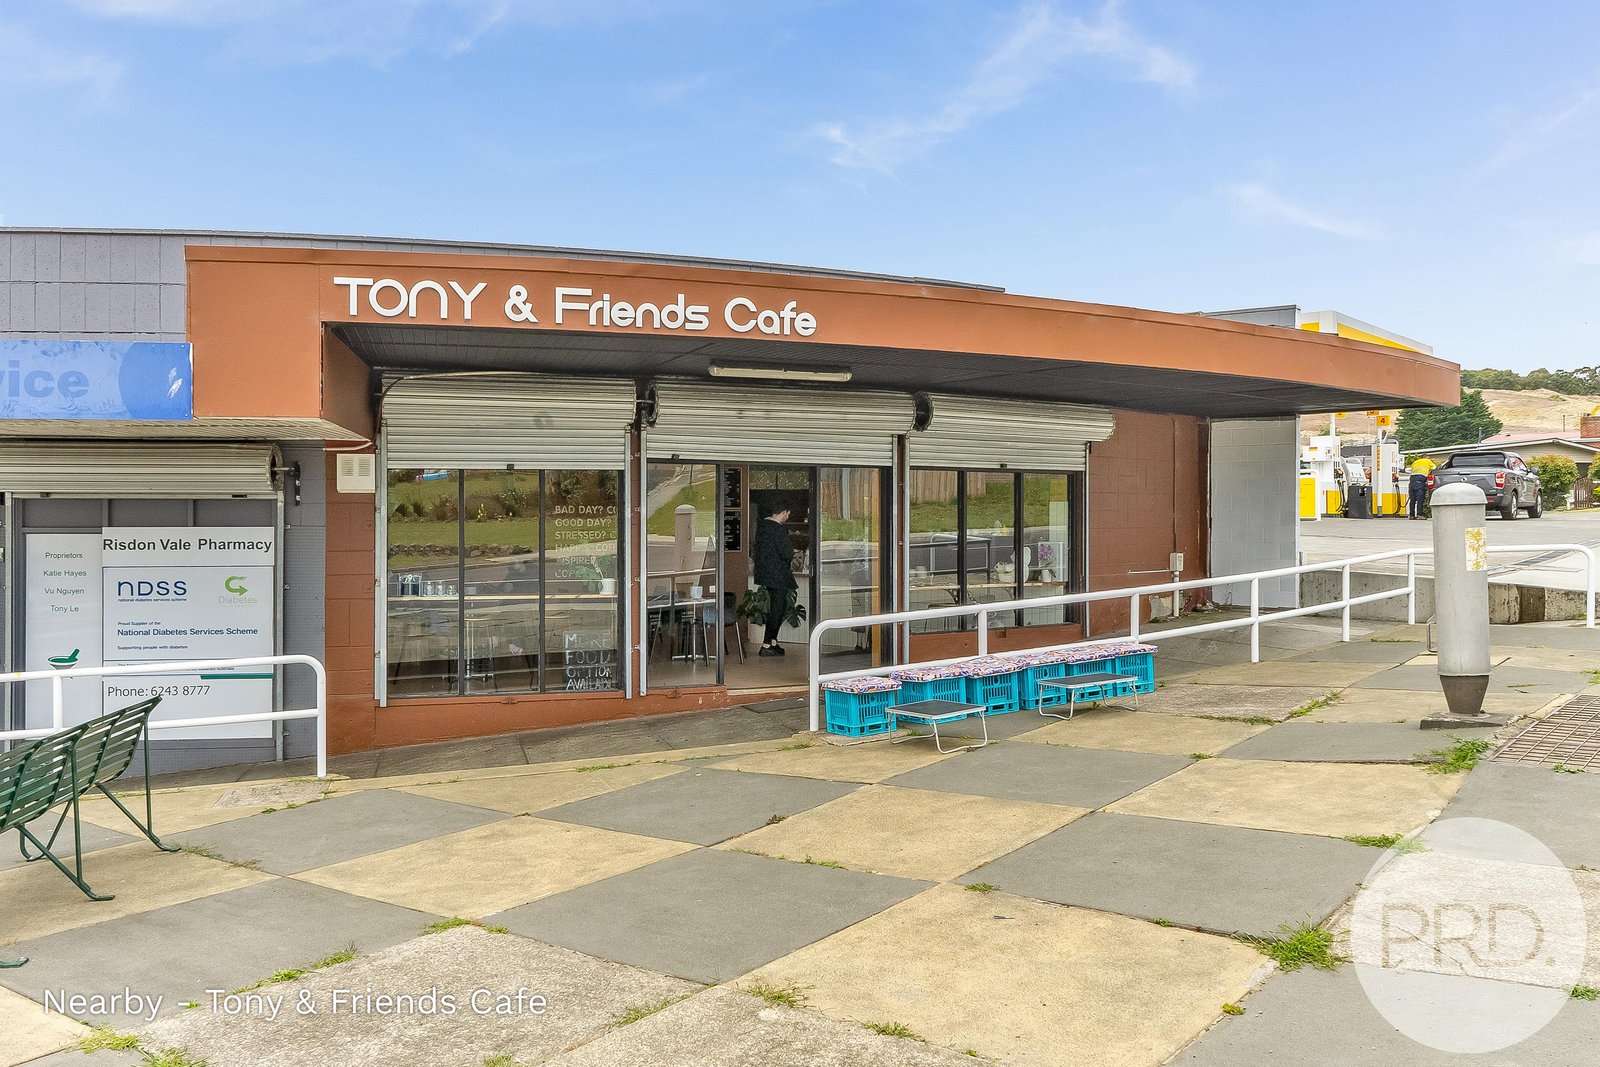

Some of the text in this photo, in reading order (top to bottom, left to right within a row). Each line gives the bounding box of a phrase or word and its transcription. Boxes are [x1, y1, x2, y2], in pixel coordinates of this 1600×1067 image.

[333, 276, 818, 337] TONY & Friends Cafe
[0, 360, 89, 399] ice
[555, 505, 575, 514] BAD
[578, 505, 603, 514] DAY?
[555, 518, 611, 527] GOOD DAY?
[555, 530, 607, 540] STRESSED?
[103, 538, 272, 552] Risdon Vale Pharmacy
[45, 551, 83, 560] Proprietors
[43, 569, 87, 579] Katie Hayes
[44, 587, 85, 597] Vu Nguyen
[50, 605, 79, 614] Tony Le
[117, 627, 258, 636] National Diabetes Services Scheme
[107, 685, 211, 697] Phone: 6243 8777
